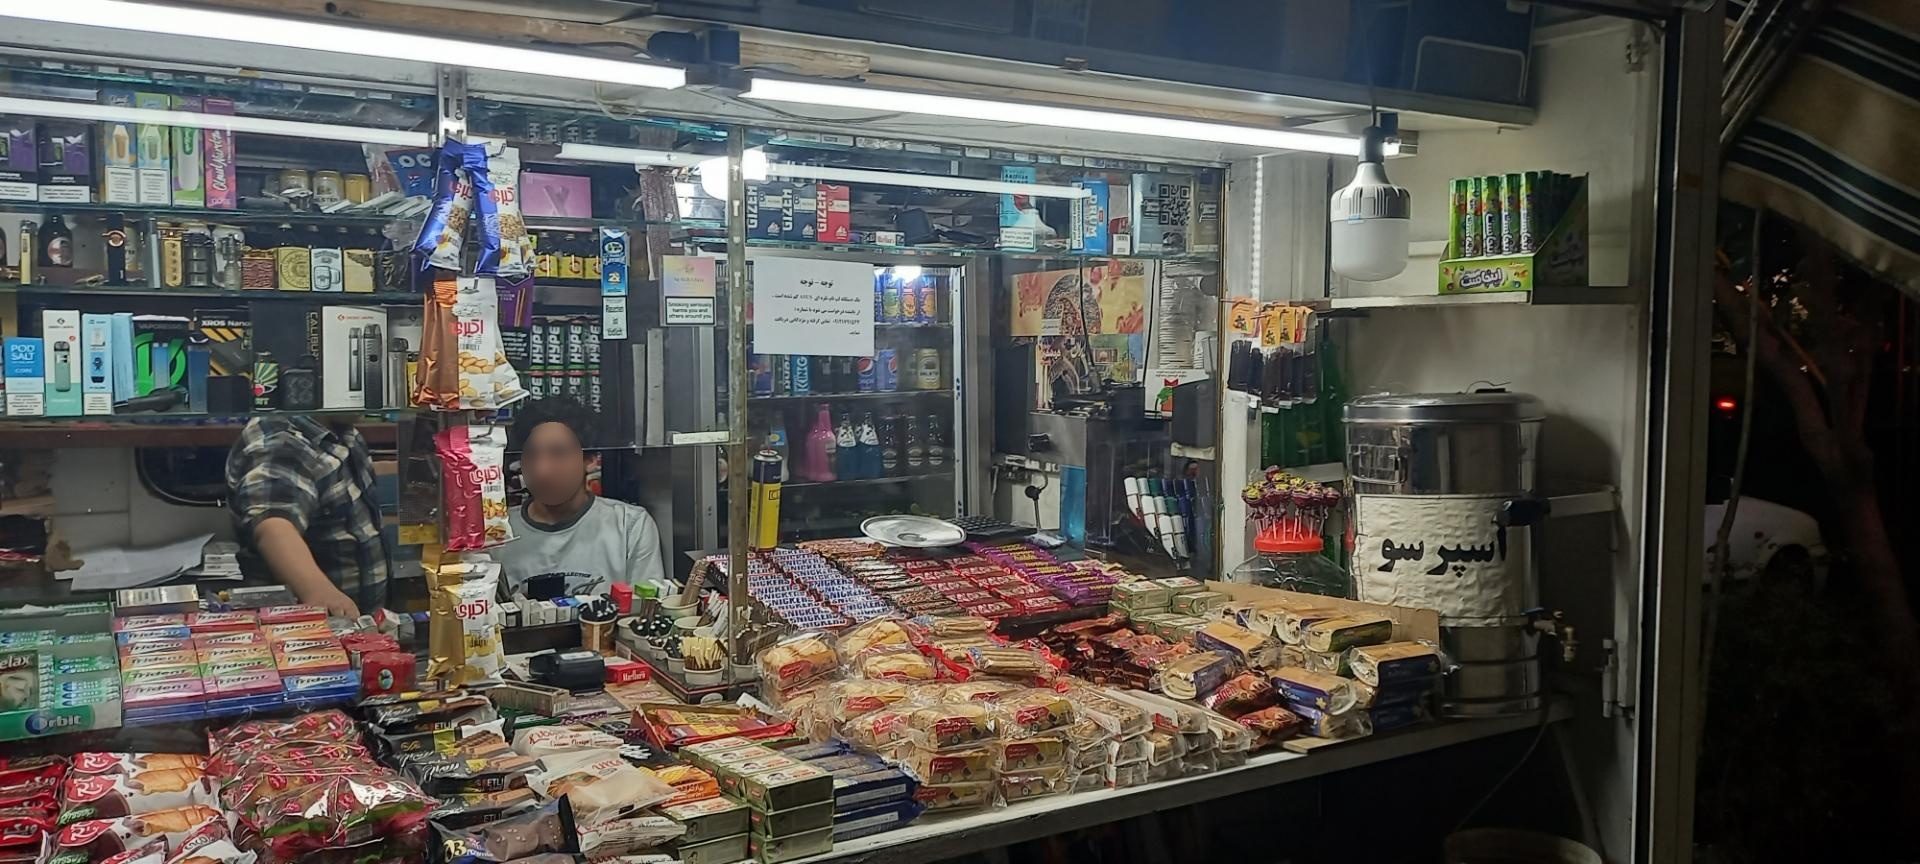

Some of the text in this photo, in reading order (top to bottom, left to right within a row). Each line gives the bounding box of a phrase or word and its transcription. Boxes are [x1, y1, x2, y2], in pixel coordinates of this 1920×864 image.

[747, 185, 758, 229] GIZEH
[782, 188, 794, 232] GIZEH
[816, 190, 828, 233] GIZEH
[1088, 194, 1098, 237] DRUM
[800, 278, 814, 288] توجه
[820, 280, 834, 288] توجه
[449, 320, 484, 338] اکبری
[310, 312, 319, 360] CALIBUR
[11, 344, 35, 353] POD
[11, 352, 36, 361] SALT
[470, 465, 501, 484] اکبری
[1377, 523, 1507, 578] اسپرسو
[749, 578, 790, 586] NICKERS
[454, 600, 488, 620] اکبری
[272, 624, 318, 633] Trident
[286, 654, 337, 663] Trident
[210, 660, 262, 671] Trident
[132, 668, 186, 678] Trident
[622, 672, 646, 682] Marlboro
[294, 674, 346, 685] Trident
[136, 683, 191, 692] Trident
[33, 715, 82, 729] Orbit
